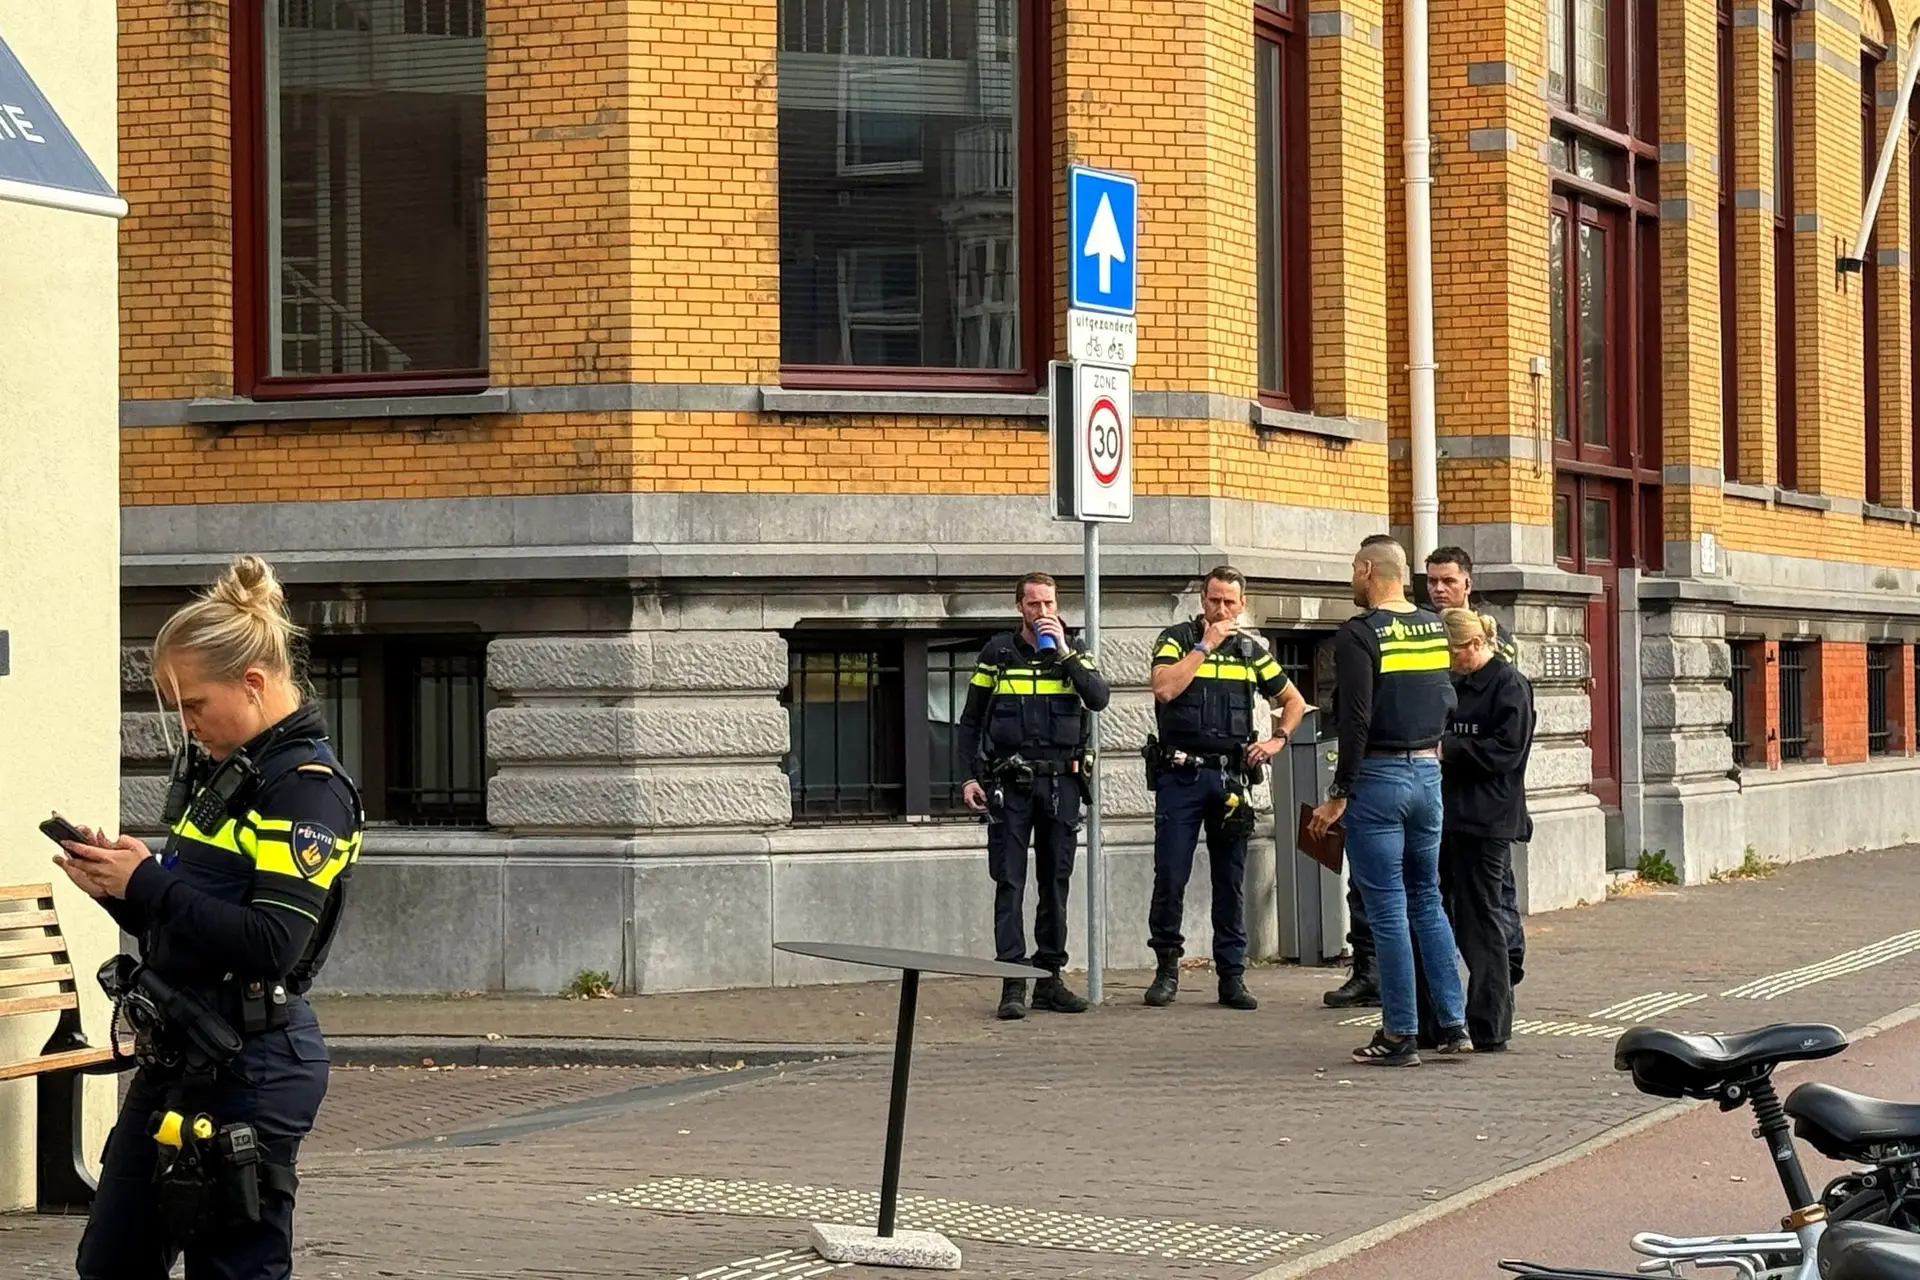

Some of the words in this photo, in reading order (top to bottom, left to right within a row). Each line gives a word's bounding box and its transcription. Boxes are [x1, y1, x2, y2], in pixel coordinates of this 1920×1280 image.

[1076, 315, 1133, 334] uitgezonderd
[1094, 374, 1116, 390] ZONE
[1094, 424, 1118, 459] 30
[1383, 618, 1438, 640] POLITIE
[1453, 723, 1479, 734] ITIE
[298, 826, 333, 845] POLITIE
